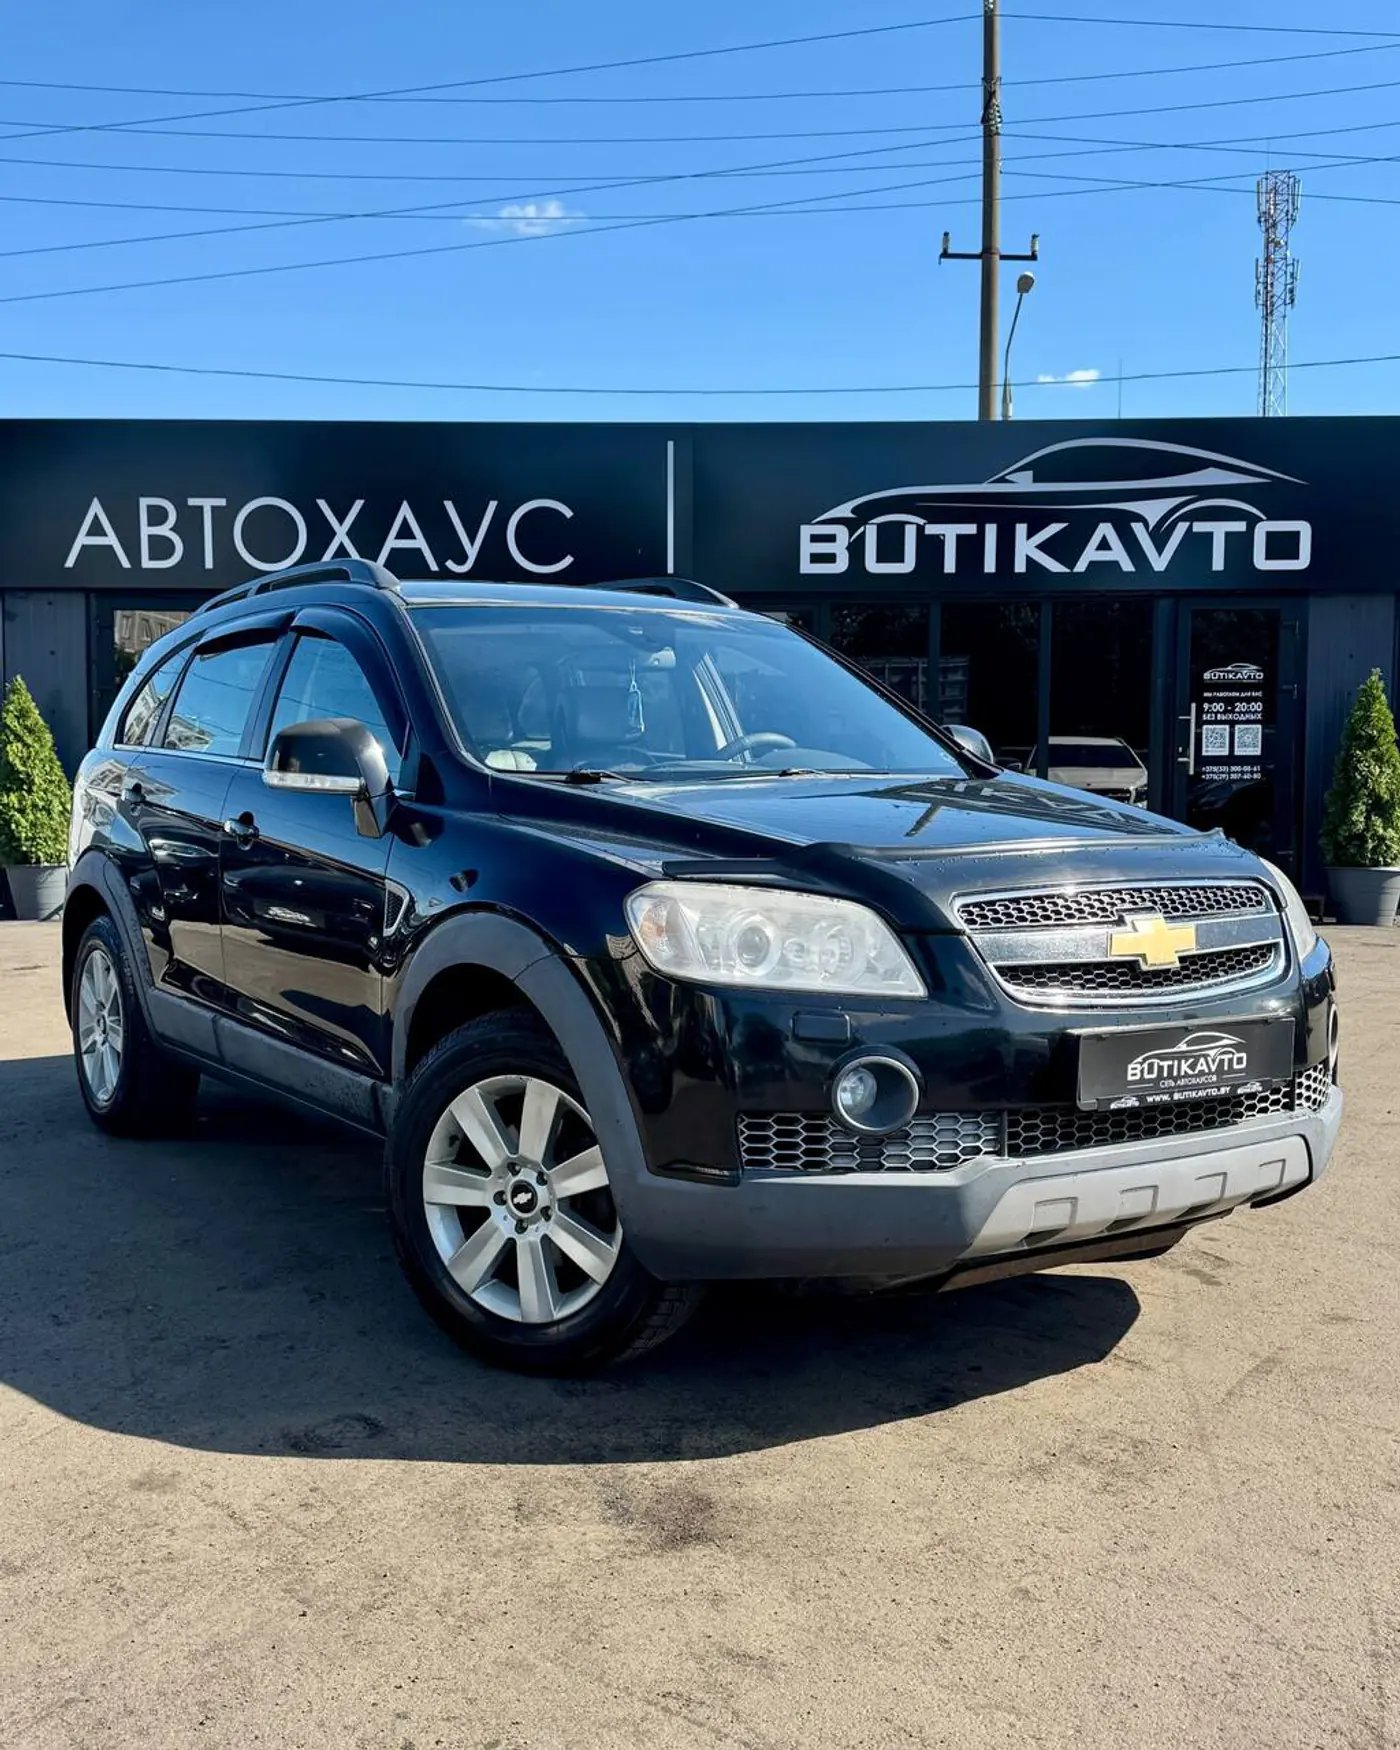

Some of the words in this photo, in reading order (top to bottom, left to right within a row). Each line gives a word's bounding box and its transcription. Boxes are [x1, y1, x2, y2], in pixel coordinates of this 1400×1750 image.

[64, 496, 574, 575] АВТОХАУС
[799, 519, 1312, 575] BUTIKAVTO
[1203, 672, 1264, 680] BUTIKAVTO
[1203, 702, 1224, 712] 9:00
[1234, 701, 1263, 711] 20:00
[1202, 713, 1215, 721] БЕЗ
[1217, 713, 1262, 721] ВЫХОДНЫХ
[1126, 1052, 1247, 1081] BUTIKAVTO
[1159, 1079, 1175, 1088] СЕТЬ
[1173, 1087, 1231, 1100] BUTIKAVTO.BY
